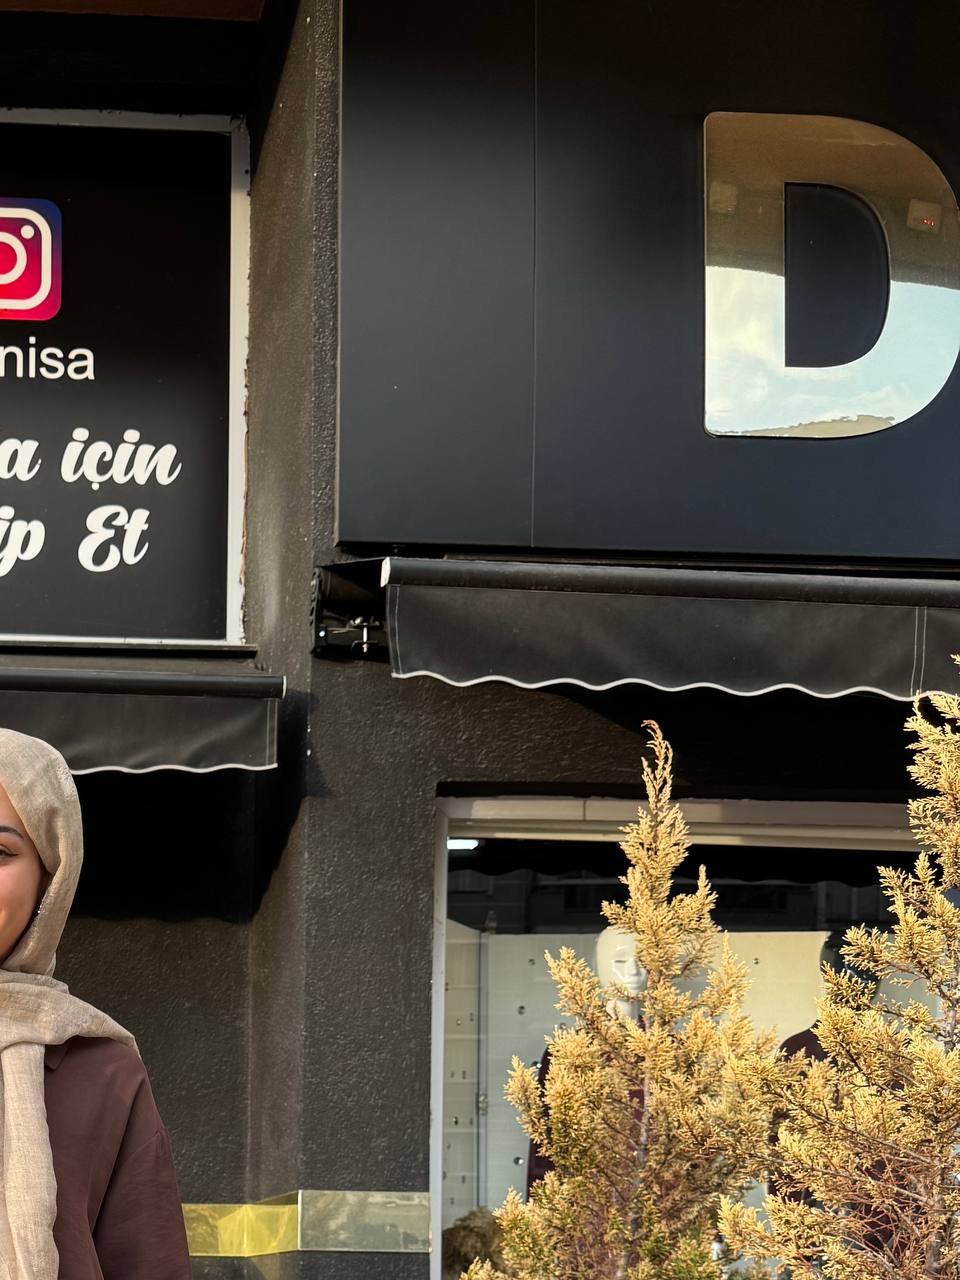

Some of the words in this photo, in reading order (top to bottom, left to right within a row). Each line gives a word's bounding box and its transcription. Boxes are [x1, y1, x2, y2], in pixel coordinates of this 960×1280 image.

[704, 111, 960, 439] D
[59, 427, 183, 491] için
[77, 504, 151, 573] Et
